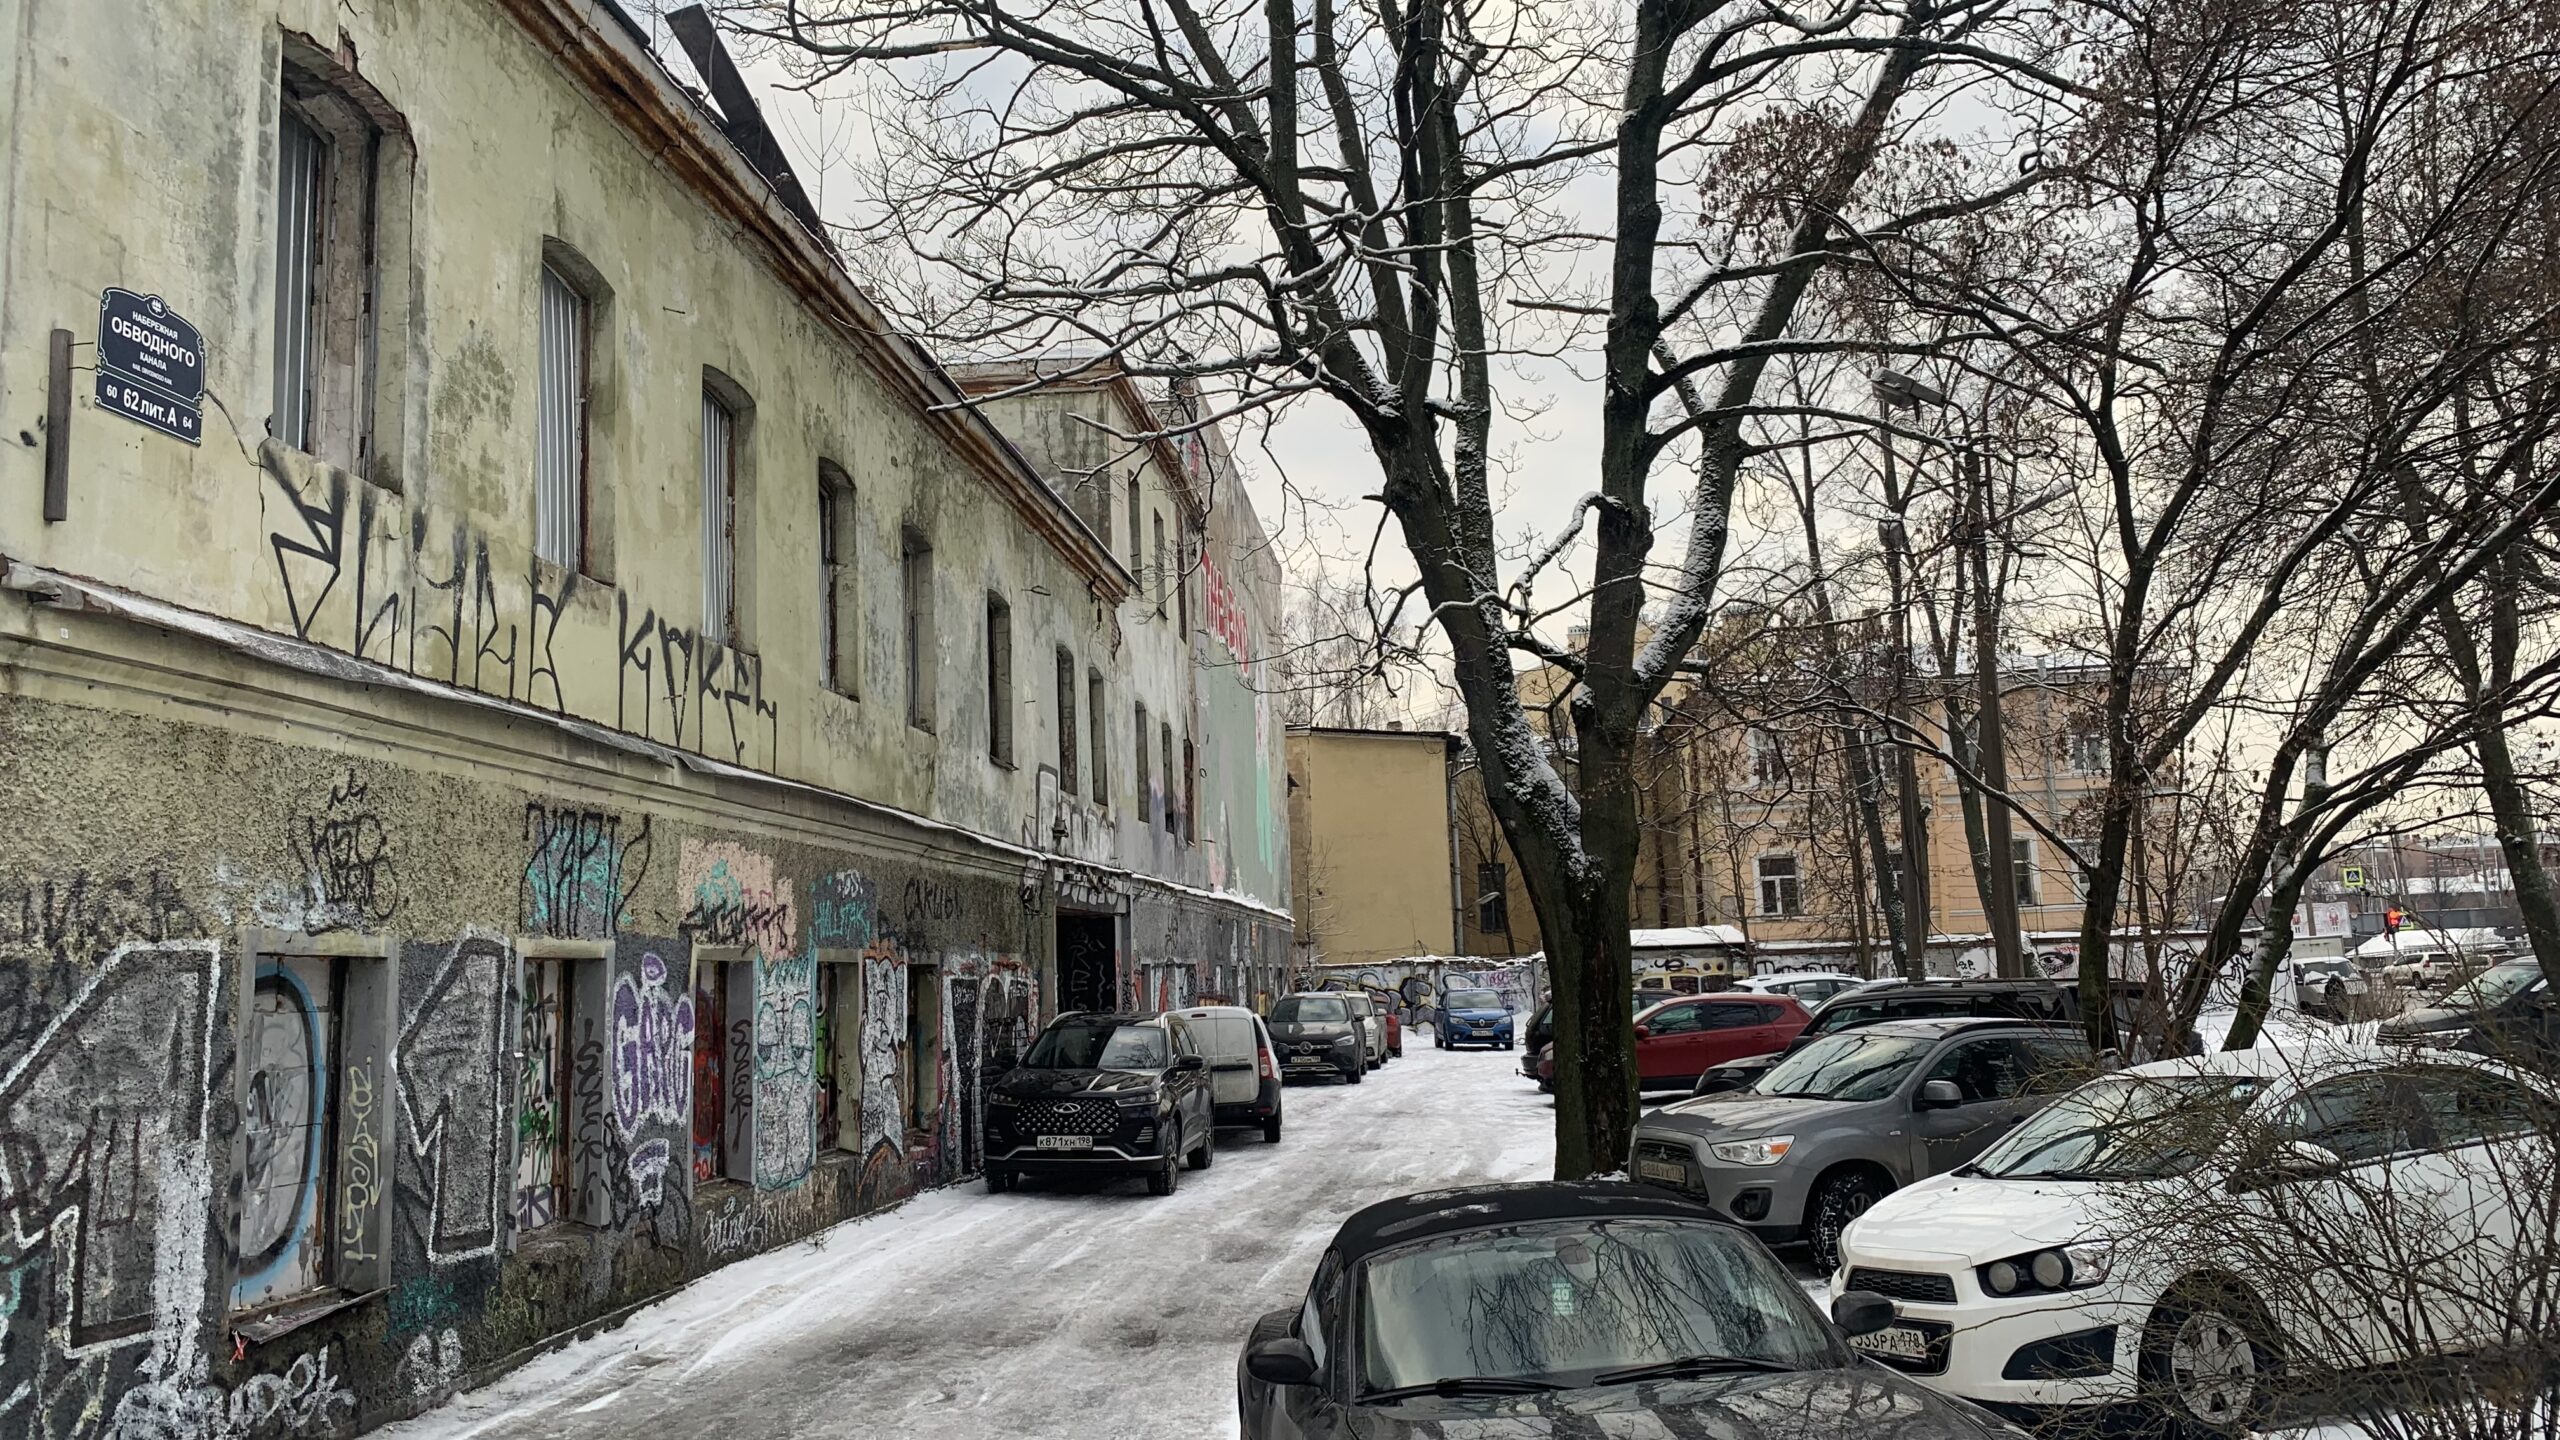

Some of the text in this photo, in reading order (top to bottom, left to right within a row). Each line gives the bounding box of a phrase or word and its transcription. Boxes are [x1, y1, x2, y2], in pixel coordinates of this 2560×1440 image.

[132, 311, 178, 340] НАБЕРЕЖНАЯ
[111, 317, 195, 367] ОБВОДНОГО
[140, 351, 167, 371] КАНАЛА
[106, 384, 118, 399] 60
[123, 388, 140, 411] 62
[182, 416, 193, 430] 64
[1077, 1137, 1092, 1145] 198
[1901, 1331, 1920, 1349] 178
